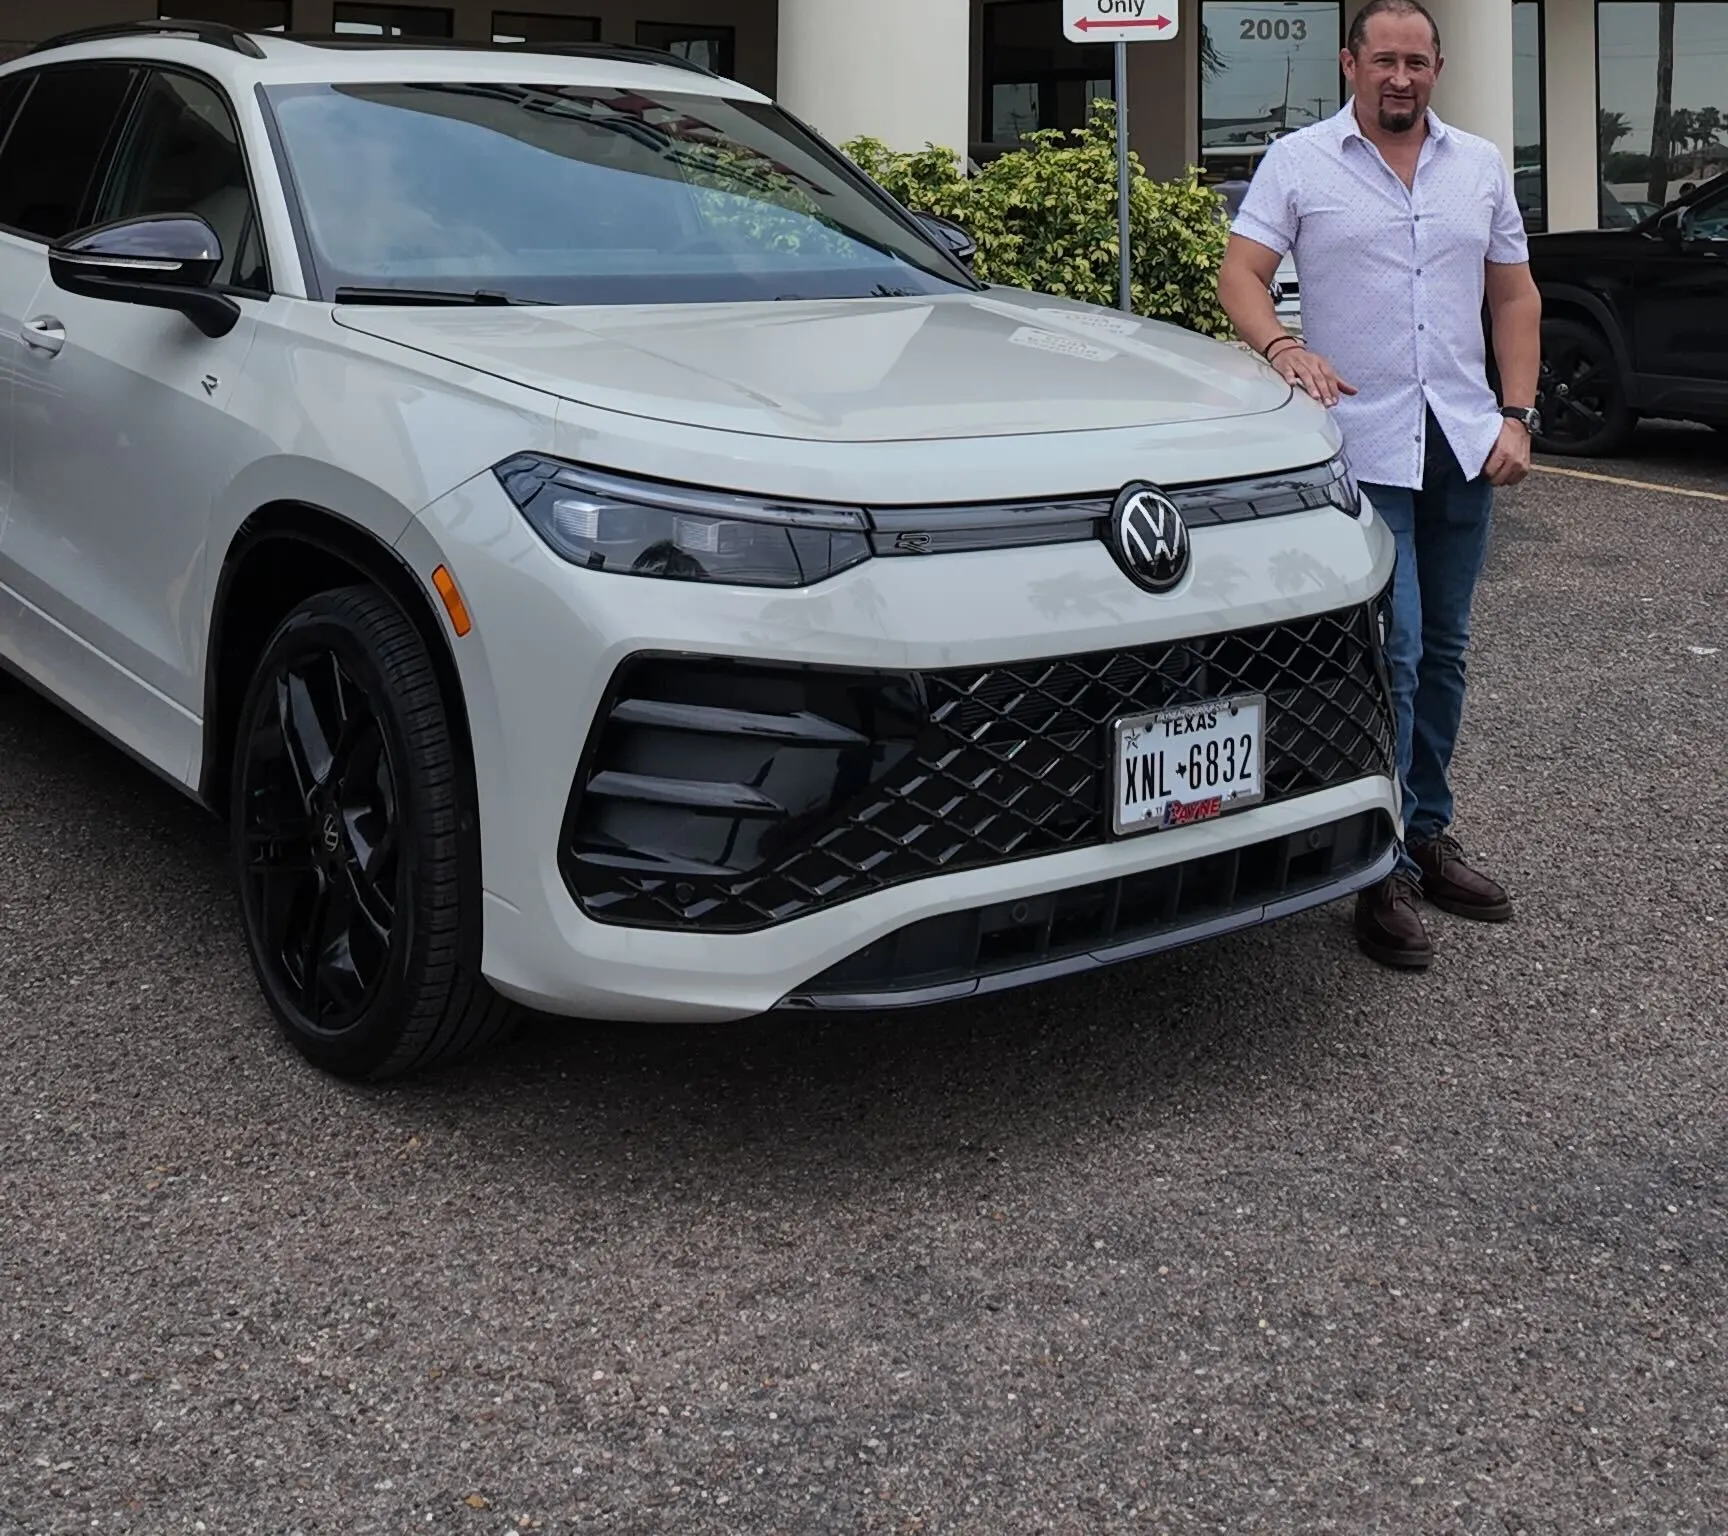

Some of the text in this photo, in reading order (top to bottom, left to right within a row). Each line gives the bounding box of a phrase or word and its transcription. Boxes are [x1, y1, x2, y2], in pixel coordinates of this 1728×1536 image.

[1239, 19, 1307, 41] 2003
[1162, 712, 1217, 737] TEXAS
[1125, 734, 1252, 805] XNL 6832
[1168, 798, 1222, 825] PAYNE
